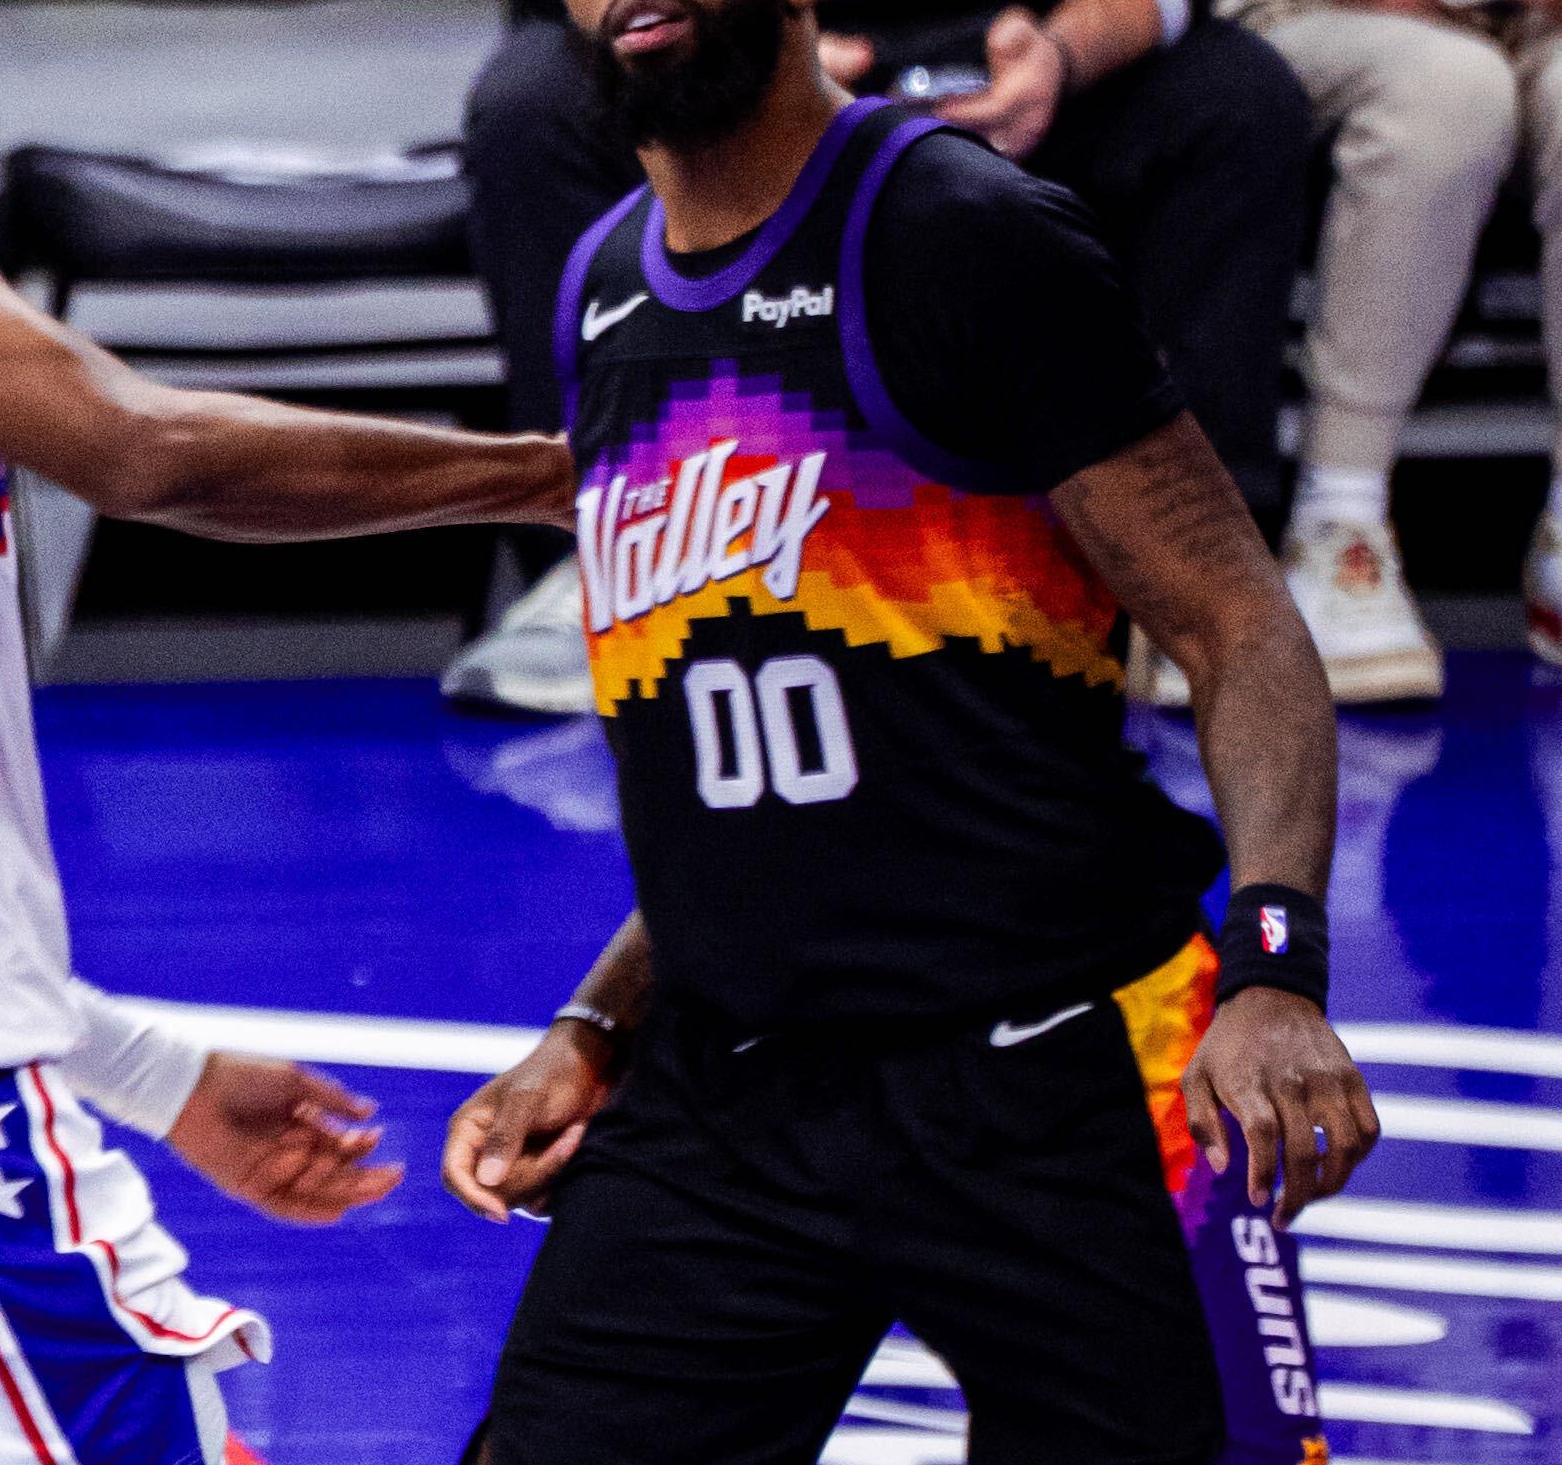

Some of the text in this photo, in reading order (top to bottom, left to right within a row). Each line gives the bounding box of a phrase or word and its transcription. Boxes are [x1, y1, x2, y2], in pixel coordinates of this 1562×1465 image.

[741, 284, 833, 329] PayPal
[575, 438, 831, 634] Valley
[621, 478, 672, 520] THE
[683, 655, 859, 810] 00
[1231, 1215, 1319, 1414] SUNS
